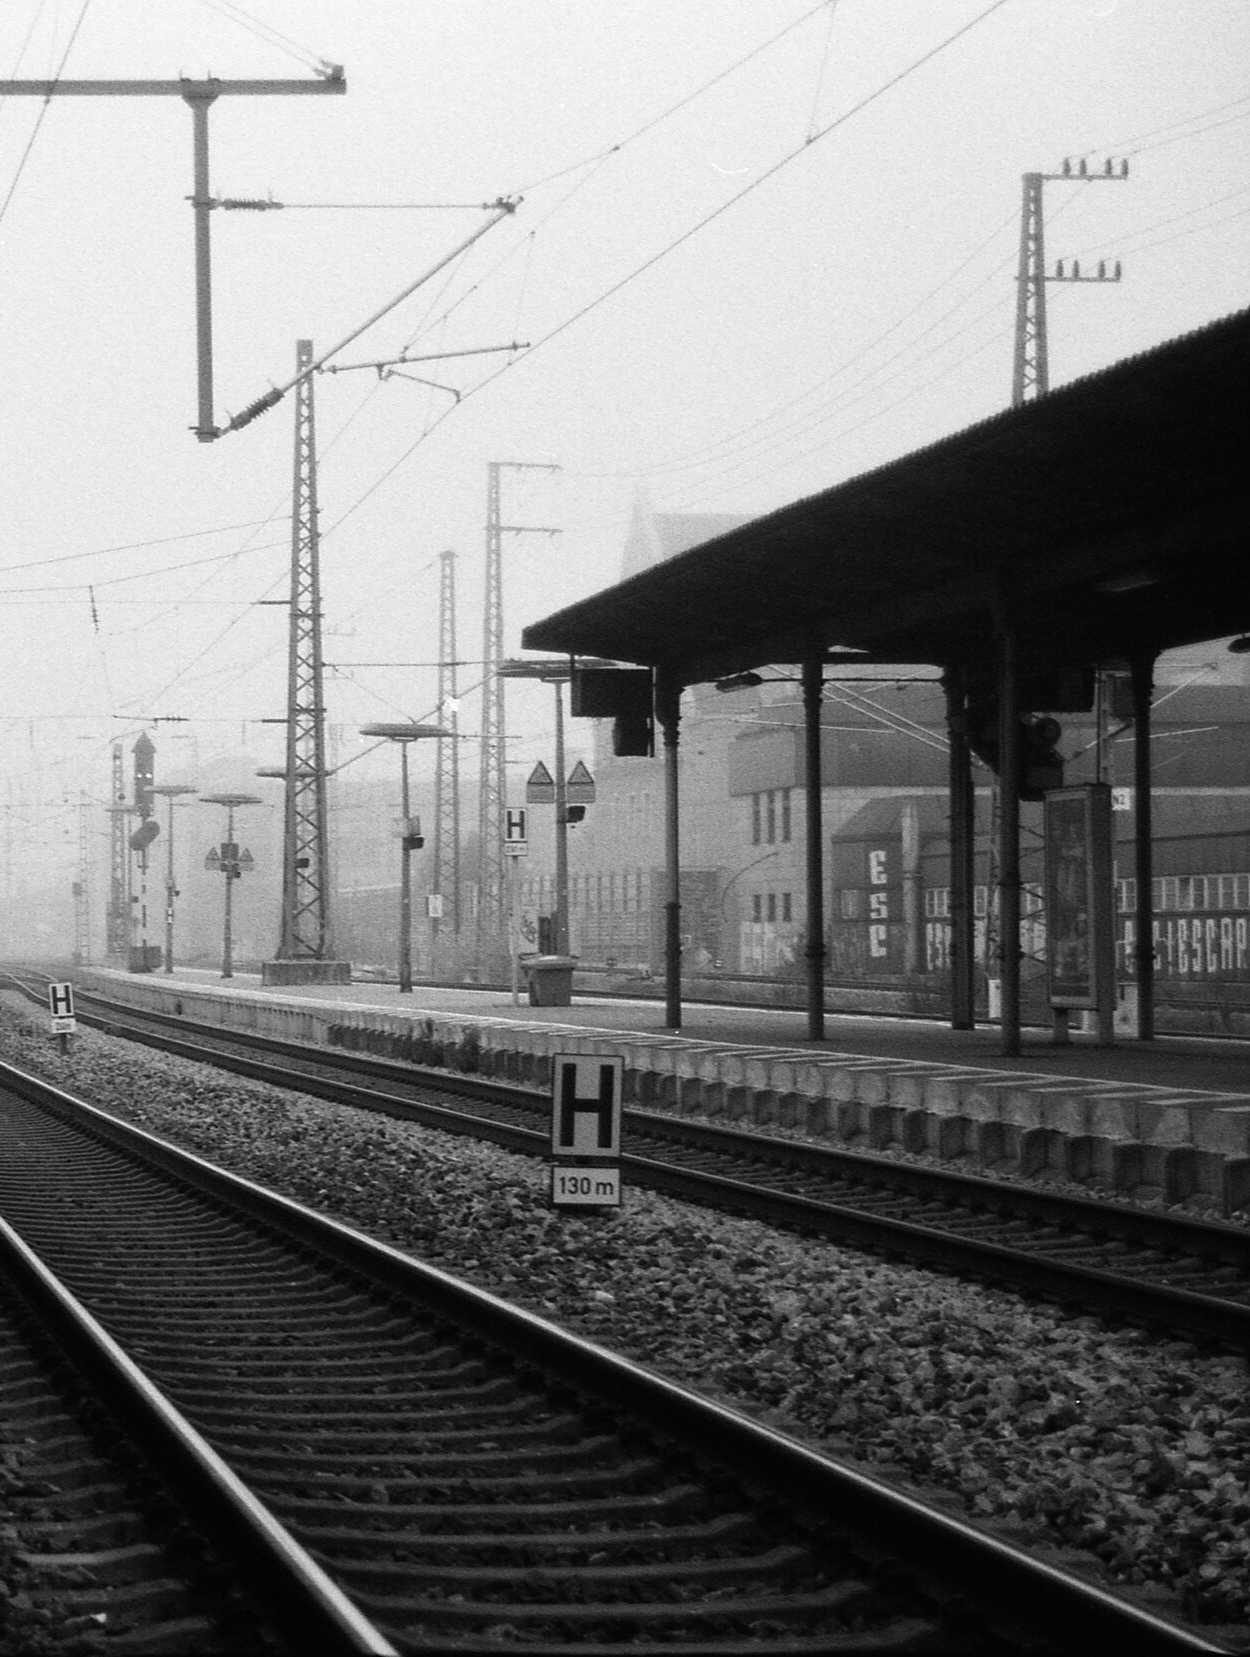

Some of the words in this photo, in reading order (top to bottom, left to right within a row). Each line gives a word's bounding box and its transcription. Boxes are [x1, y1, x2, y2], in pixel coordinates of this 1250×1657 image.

[507, 810, 525, 838] H
[869, 849, 888, 957] ESC
[52, 985, 71, 1014] H
[560, 1063, 614, 1148] H
[559, 1176, 591, 1195] 130
[596, 1181, 614, 1195] m
